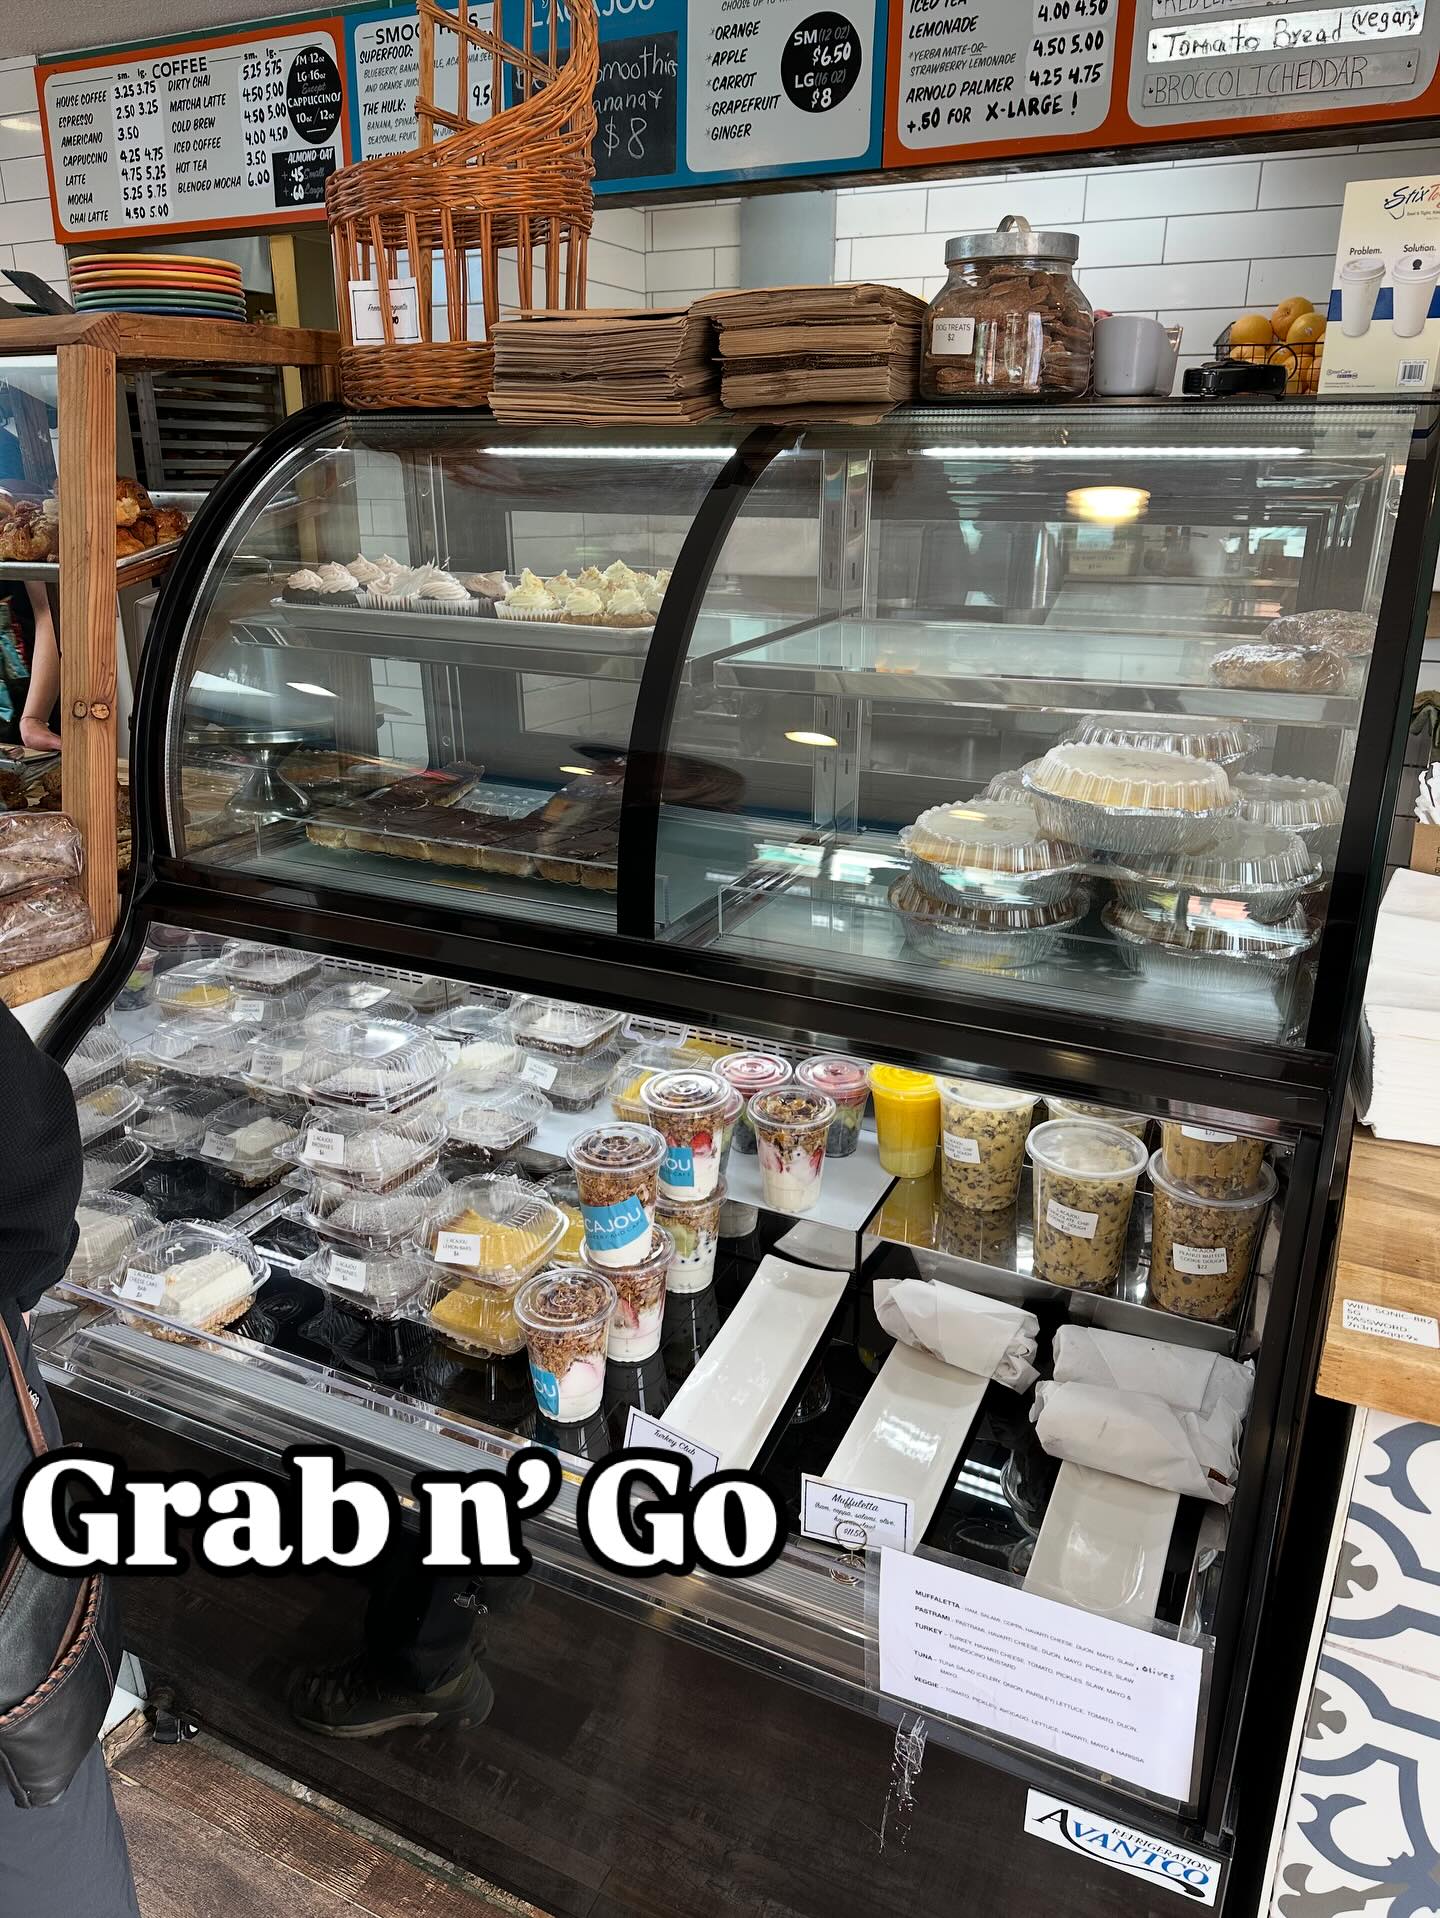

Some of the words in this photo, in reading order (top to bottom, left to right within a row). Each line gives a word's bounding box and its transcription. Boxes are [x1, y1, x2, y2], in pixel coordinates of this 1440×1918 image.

[1038, 0, 1070, 22] 4.00
[1075, 0, 1108, 16] 4.50
[715, 20, 760, 40] ORANGE
[794, 29, 818, 46] SM
[909, 15, 979, 39] LEMONADE
[1033, 37, 1066, 57] 4.50
[1070, 30, 1104, 54] 5.00
[1273, 13, 1343, 49] Bread
[138, 68, 146, 80] lg.
[152, 56, 207, 79] COFFEE
[244, 51, 258, 61] sm.
[266, 48, 276, 60] lg.
[360, 44, 413, 64] SUPERFOOD:
[712, 48, 748, 67] APPLE
[812, 41, 852, 66] $6.50
[364, 65, 398, 79] BLUEBERRY,
[910, 60, 967, 77] STRAWBERRY
[969, 53, 1016, 69] LEMONADE
[168, 77, 190, 92] DIRTY
[192, 74, 210, 89] CHAI
[365, 82, 377, 94] AND
[380, 79, 402, 92] ORANGE
[712, 72, 757, 92] CARROT
[794, 72, 814, 89] LG
[906, 82, 956, 104] ARNOLD
[960, 76, 1014, 97] PALMER
[1030, 67, 1062, 87] 4.25
[1068, 63, 1104, 85] 4.75
[56, 94, 79, 109] HOUSE
[81, 90, 107, 106] COFFEE
[115, 84, 134, 100] 3.25
[137, 80, 156, 96] 3.75
[170, 97, 201, 113] MATCHA
[204, 93, 226, 108] LATTE
[243, 86, 263, 103] 4.50
[266, 80, 284, 101] 5.00
[288, 91, 341, 108] CAPPUCCINOS
[473, 84, 493, 107] 9.5
[712, 94, 782, 117] GRAPEFRUIT
[811, 87, 831, 109] $8
[59, 112, 93, 129] ESPRESSO
[116, 104, 135, 120] 2.50
[138, 99, 158, 116] 3.25
[172, 119, 191, 134] COLD
[193, 116, 216, 130] BREW
[244, 108, 264, 124] 4.50
[268, 102, 286, 120] 5.00
[363, 101, 379, 117] THE
[381, 98, 406, 114] HULK:
[907, 106, 940, 134] +.50
[947, 106, 972, 124] FOR
[986, 94, 1063, 122] X-LARGE
[367, 119, 392, 131] BANANA,
[711, 123, 751, 141] GINGER
[61, 131, 102, 148] AMERICANO
[118, 125, 139, 142] 3.50
[174, 140, 190, 154] ICED
[193, 136, 221, 152] COFFEE
[246, 129, 266, 146] 4.00
[270, 126, 288, 142] 4.50
[368, 133, 397, 145] SEASONAL
[63, 151, 107, 168] CAPPUCCINO
[145, 146, 163, 162] 4.75
[176, 161, 190, 174] HOT
[193, 159, 207, 172] TEA
[247, 150, 266, 167] 3.50
[66, 173, 86, 187] LATTE
[121, 166, 142, 182] 4.75
[146, 164, 166, 181] 5.25
[178, 179, 211, 194] BLENDED
[214, 175, 241, 190] MOCHA
[248, 169, 270, 187] 6.00
[68, 192, 93, 206] MOCHA
[123, 184, 142, 201] 5.25
[147, 183, 167, 200] 5.75
[70, 212, 86, 225] CHAI
[88, 209, 108, 223] LATTE
[126, 206, 145, 220] 4.50
[150, 203, 168, 219] 5.00
[1350, 245, 1382, 256] Problem.
[948, 323, 971, 332] TREATS
[679, 1442, 696, 1456] Club
[832, 1493, 878, 1512] Muffuletta
[915, 1590, 960, 1609] MUFFALETTA
[915, 1605, 950, 1621] PASTRAMI
[915, 1622, 942, 1635] TURKEY
[914, 1650, 932, 1661] TUNA
[956, 1664, 975, 1675] SALAD
[914, 1675, 939, 1689] VEGGIE
[1032, 1808, 1209, 1890] AVANTCO
[1111, 1828, 1212, 1872] REFRIGERATION
